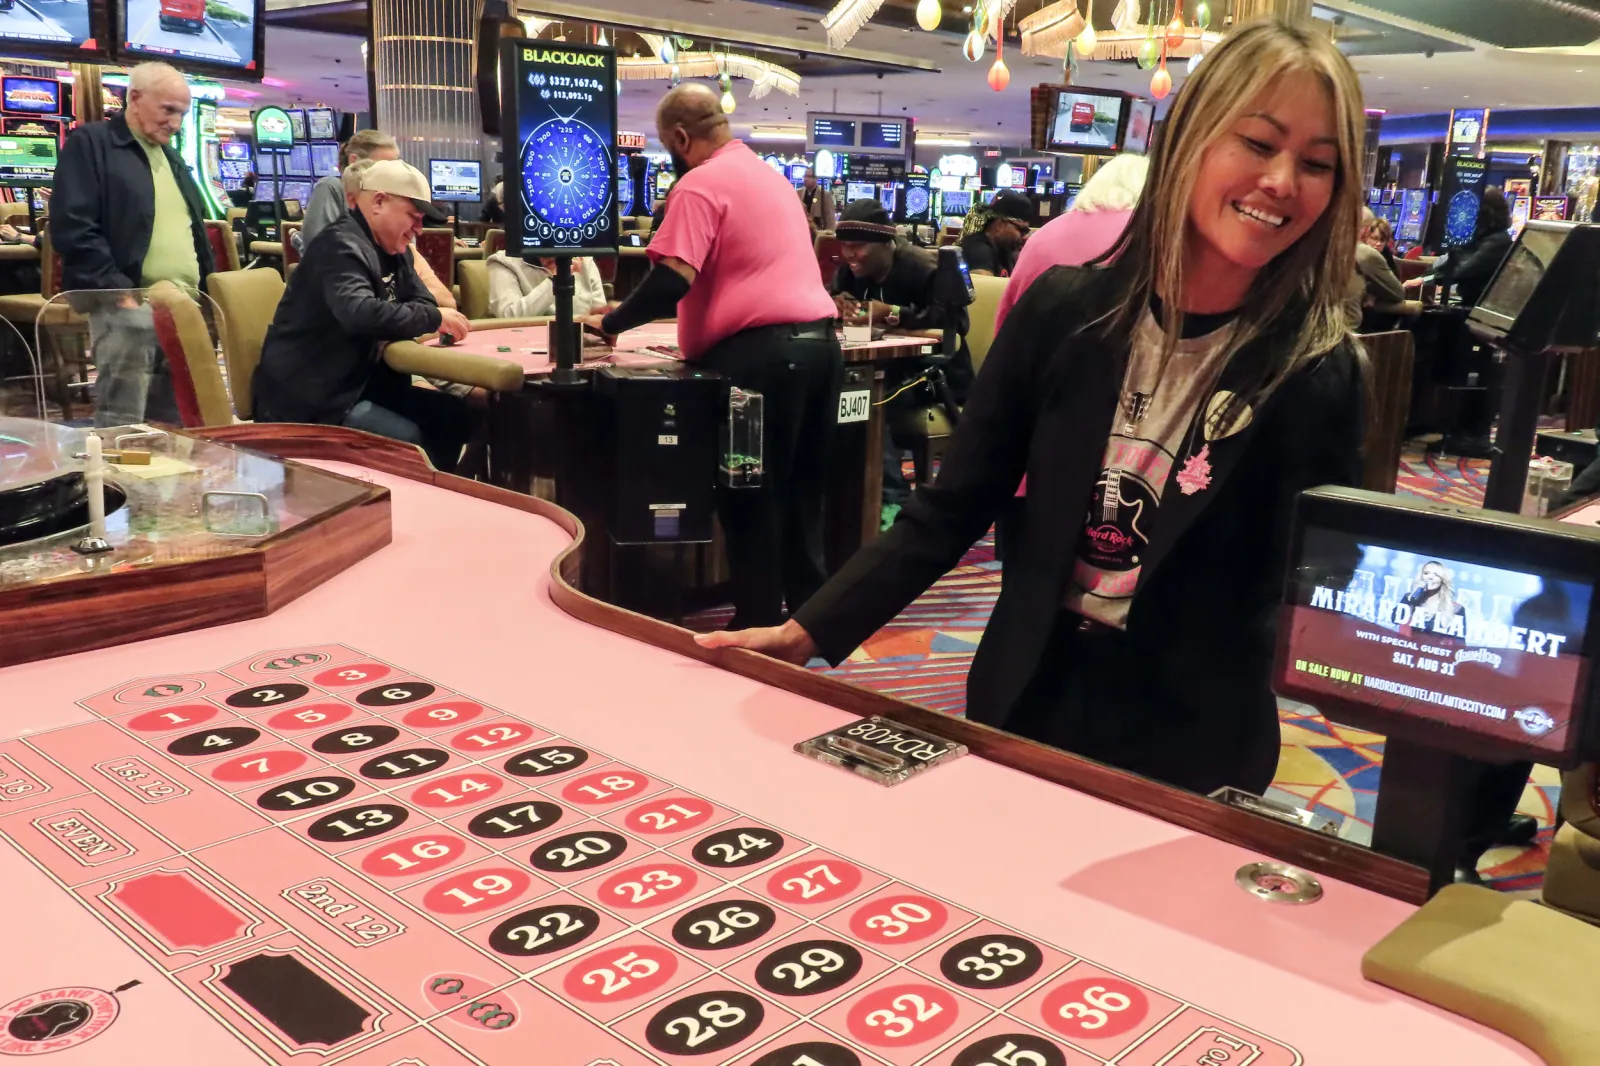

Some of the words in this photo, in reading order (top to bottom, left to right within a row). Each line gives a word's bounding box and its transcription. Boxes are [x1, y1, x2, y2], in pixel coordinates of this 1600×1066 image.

[523, 48, 605, 68] BLACKJACK
[549, 75, 603, 92] $327,167.00
[528, 218, 535, 227] 6
[543, 227, 548, 235] 5
[557, 231, 563, 239] 4
[573, 231, 579, 239] 3
[587, 227, 593, 235] 2
[600, 218, 605, 226] 1
[840, 395, 868, 418] BJ407
[664, 436, 674, 444] 13
[1109, 532, 1134, 547] Rock
[1309, 585, 1428, 631] MIRANDA
[1431, 609, 1567, 659] LAMBERT
[1355, 629, 1380, 642] WITH
[1380, 635, 1419, 651] SPECIAL
[1420, 644, 1453, 658] GUEST
[338, 670, 366, 680] 3
[1392, 651, 1414, 668] SAT,
[1416, 656, 1440, 673] AUG
[1440, 661, 1456, 677] 31
[253, 690, 284, 701] 2
[383, 689, 411, 699] 6
[1295, 659, 1308, 672] ON
[1308, 662, 1330, 677] SALE
[1330, 667, 1352, 682] NOW
[1351, 673, 1364, 685] AT
[1363, 675, 1506, 720] HARDROCKHOTELATLANTICCITY.COM
[161, 713, 189, 723] 1
[295, 710, 326, 722] 5
[428, 709, 458, 720] 9
[204, 735, 232, 746] 4
[341, 733, 373, 745] 8
[467, 728, 521, 746] 12
[847, 722, 949, 761] RD408
[242, 758, 268, 772] 7
[377, 754, 435, 774] 11
[519, 749, 575, 773] 15
[108, 762, 150, 782] 1st
[136, 780, 175, 797] 12
[273, 778, 338, 806] 10
[427, 778, 491, 803] 14
[578, 776, 635, 799] 18
[327, 808, 394, 837] 13
[485, 804, 542, 833] 17
[639, 803, 702, 830] 21
[50, 817, 117, 856] EVEN
[707, 832, 773, 864] 24
[381, 840, 450, 871] 16
[545, 836, 612, 867] 20
[443, 874, 513, 908] 19
[613, 870, 682, 904] 23
[783, 865, 841, 898] 27
[295, 883, 359, 918] 2nd
[341, 914, 390, 941] 12
[688, 906, 760, 944] 26
[866, 903, 931, 936] 30
[507, 912, 585, 950] 22
[581, 951, 660, 996] 25
[773, 949, 843, 988] 29
[958, 943, 1025, 980] 33
[39, 989, 95, 1001] BAND
[1060, 987, 1130, 1029] 36
[664, 999, 746, 1048] 28
[864, 993, 944, 1038] 32
